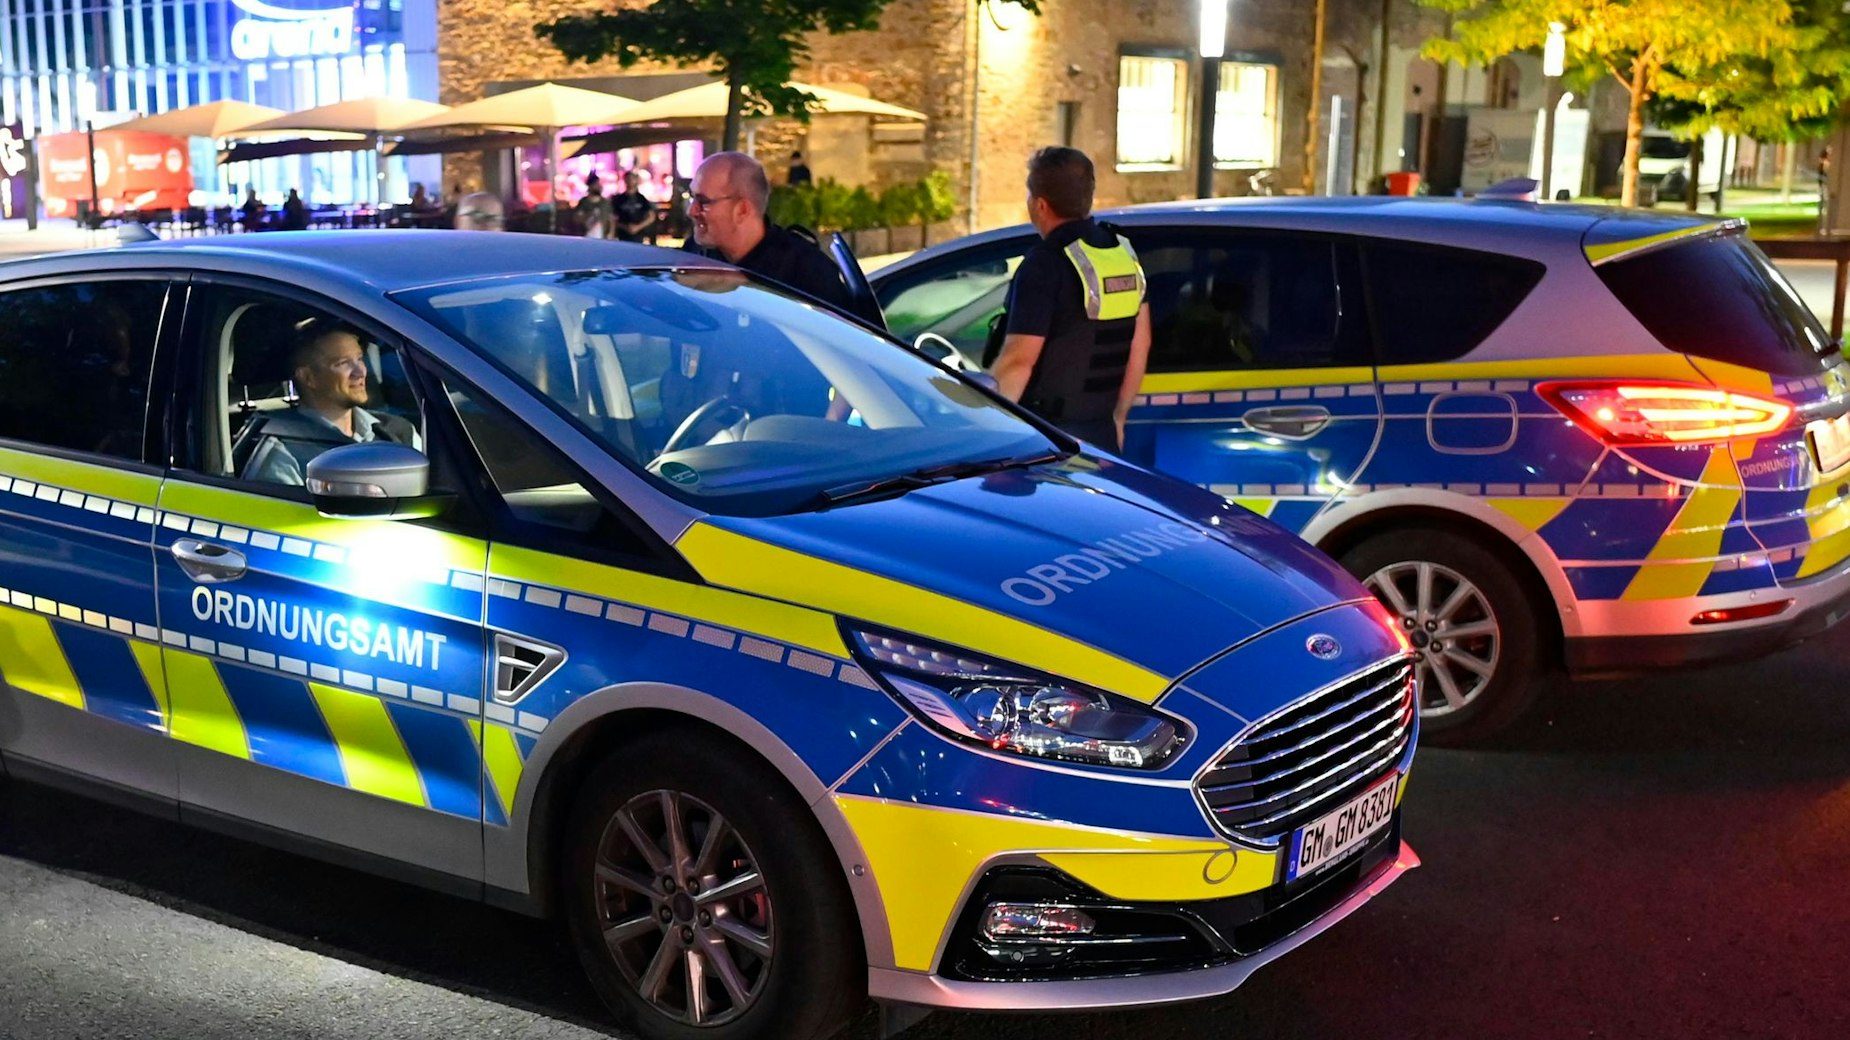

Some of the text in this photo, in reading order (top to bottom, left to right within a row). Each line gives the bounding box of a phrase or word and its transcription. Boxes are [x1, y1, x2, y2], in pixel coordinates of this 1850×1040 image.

[191, 586, 447, 671] ORDNUNGSAMT
[1301, 822, 1326, 868] GM
[1335, 803, 1358, 848] GM
[1358, 781, 1394, 834] 8381
